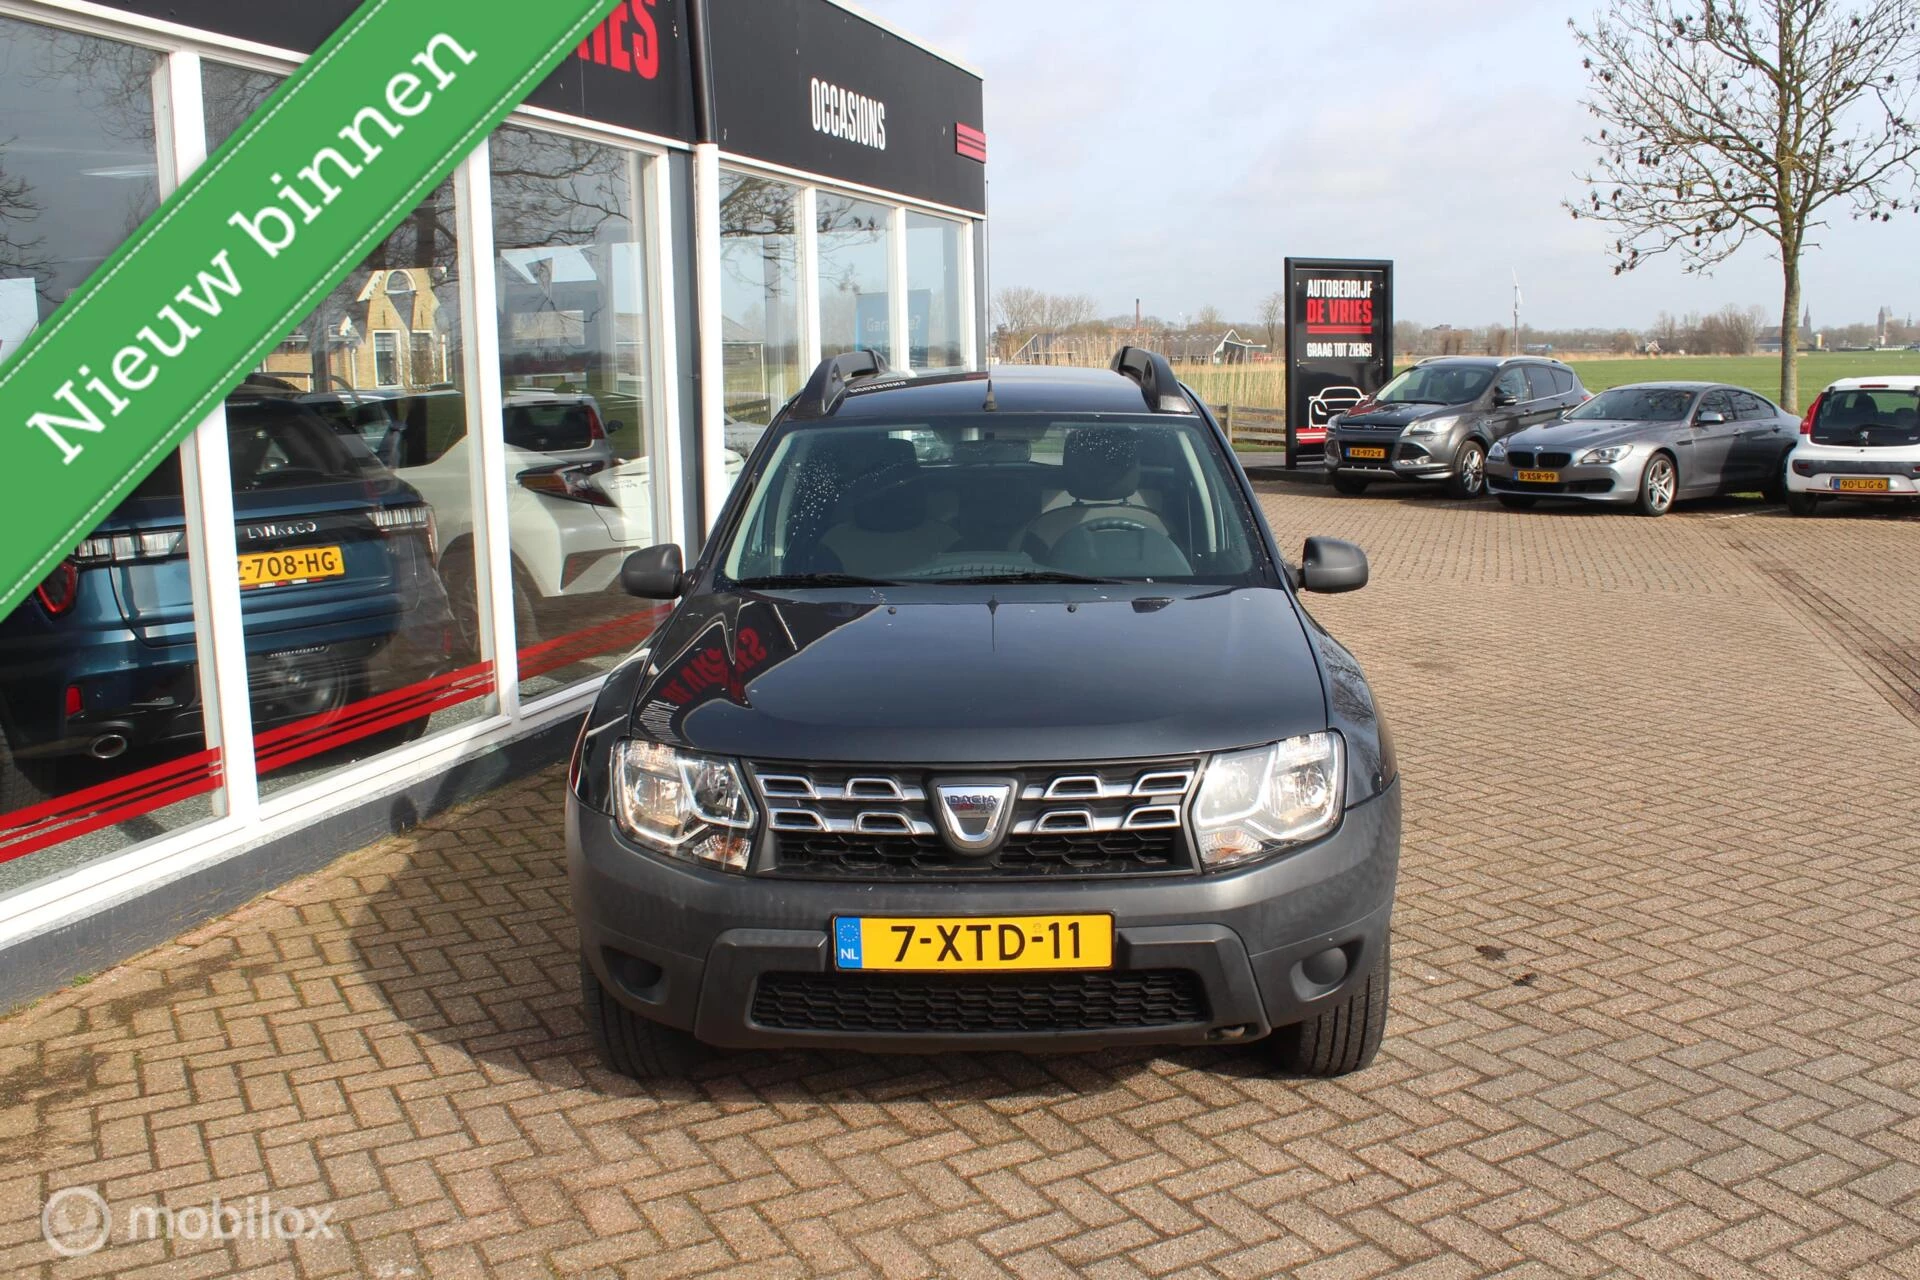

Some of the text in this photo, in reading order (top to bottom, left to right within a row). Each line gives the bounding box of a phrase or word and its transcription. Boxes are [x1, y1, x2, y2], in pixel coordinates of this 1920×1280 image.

[811, 77, 886, 151] OCCASIONS
[1306, 279, 1373, 298] AUTOBEDRIJF
[1306, 299, 1373, 324] DE VRIES
[1306, 342, 1373, 358] GRAAG TOT ZIENS!
[949, 795, 997, 805] DACIA
[890, 921, 1081, 962] 7-XTD-11
[840, 948, 859, 960] NL
